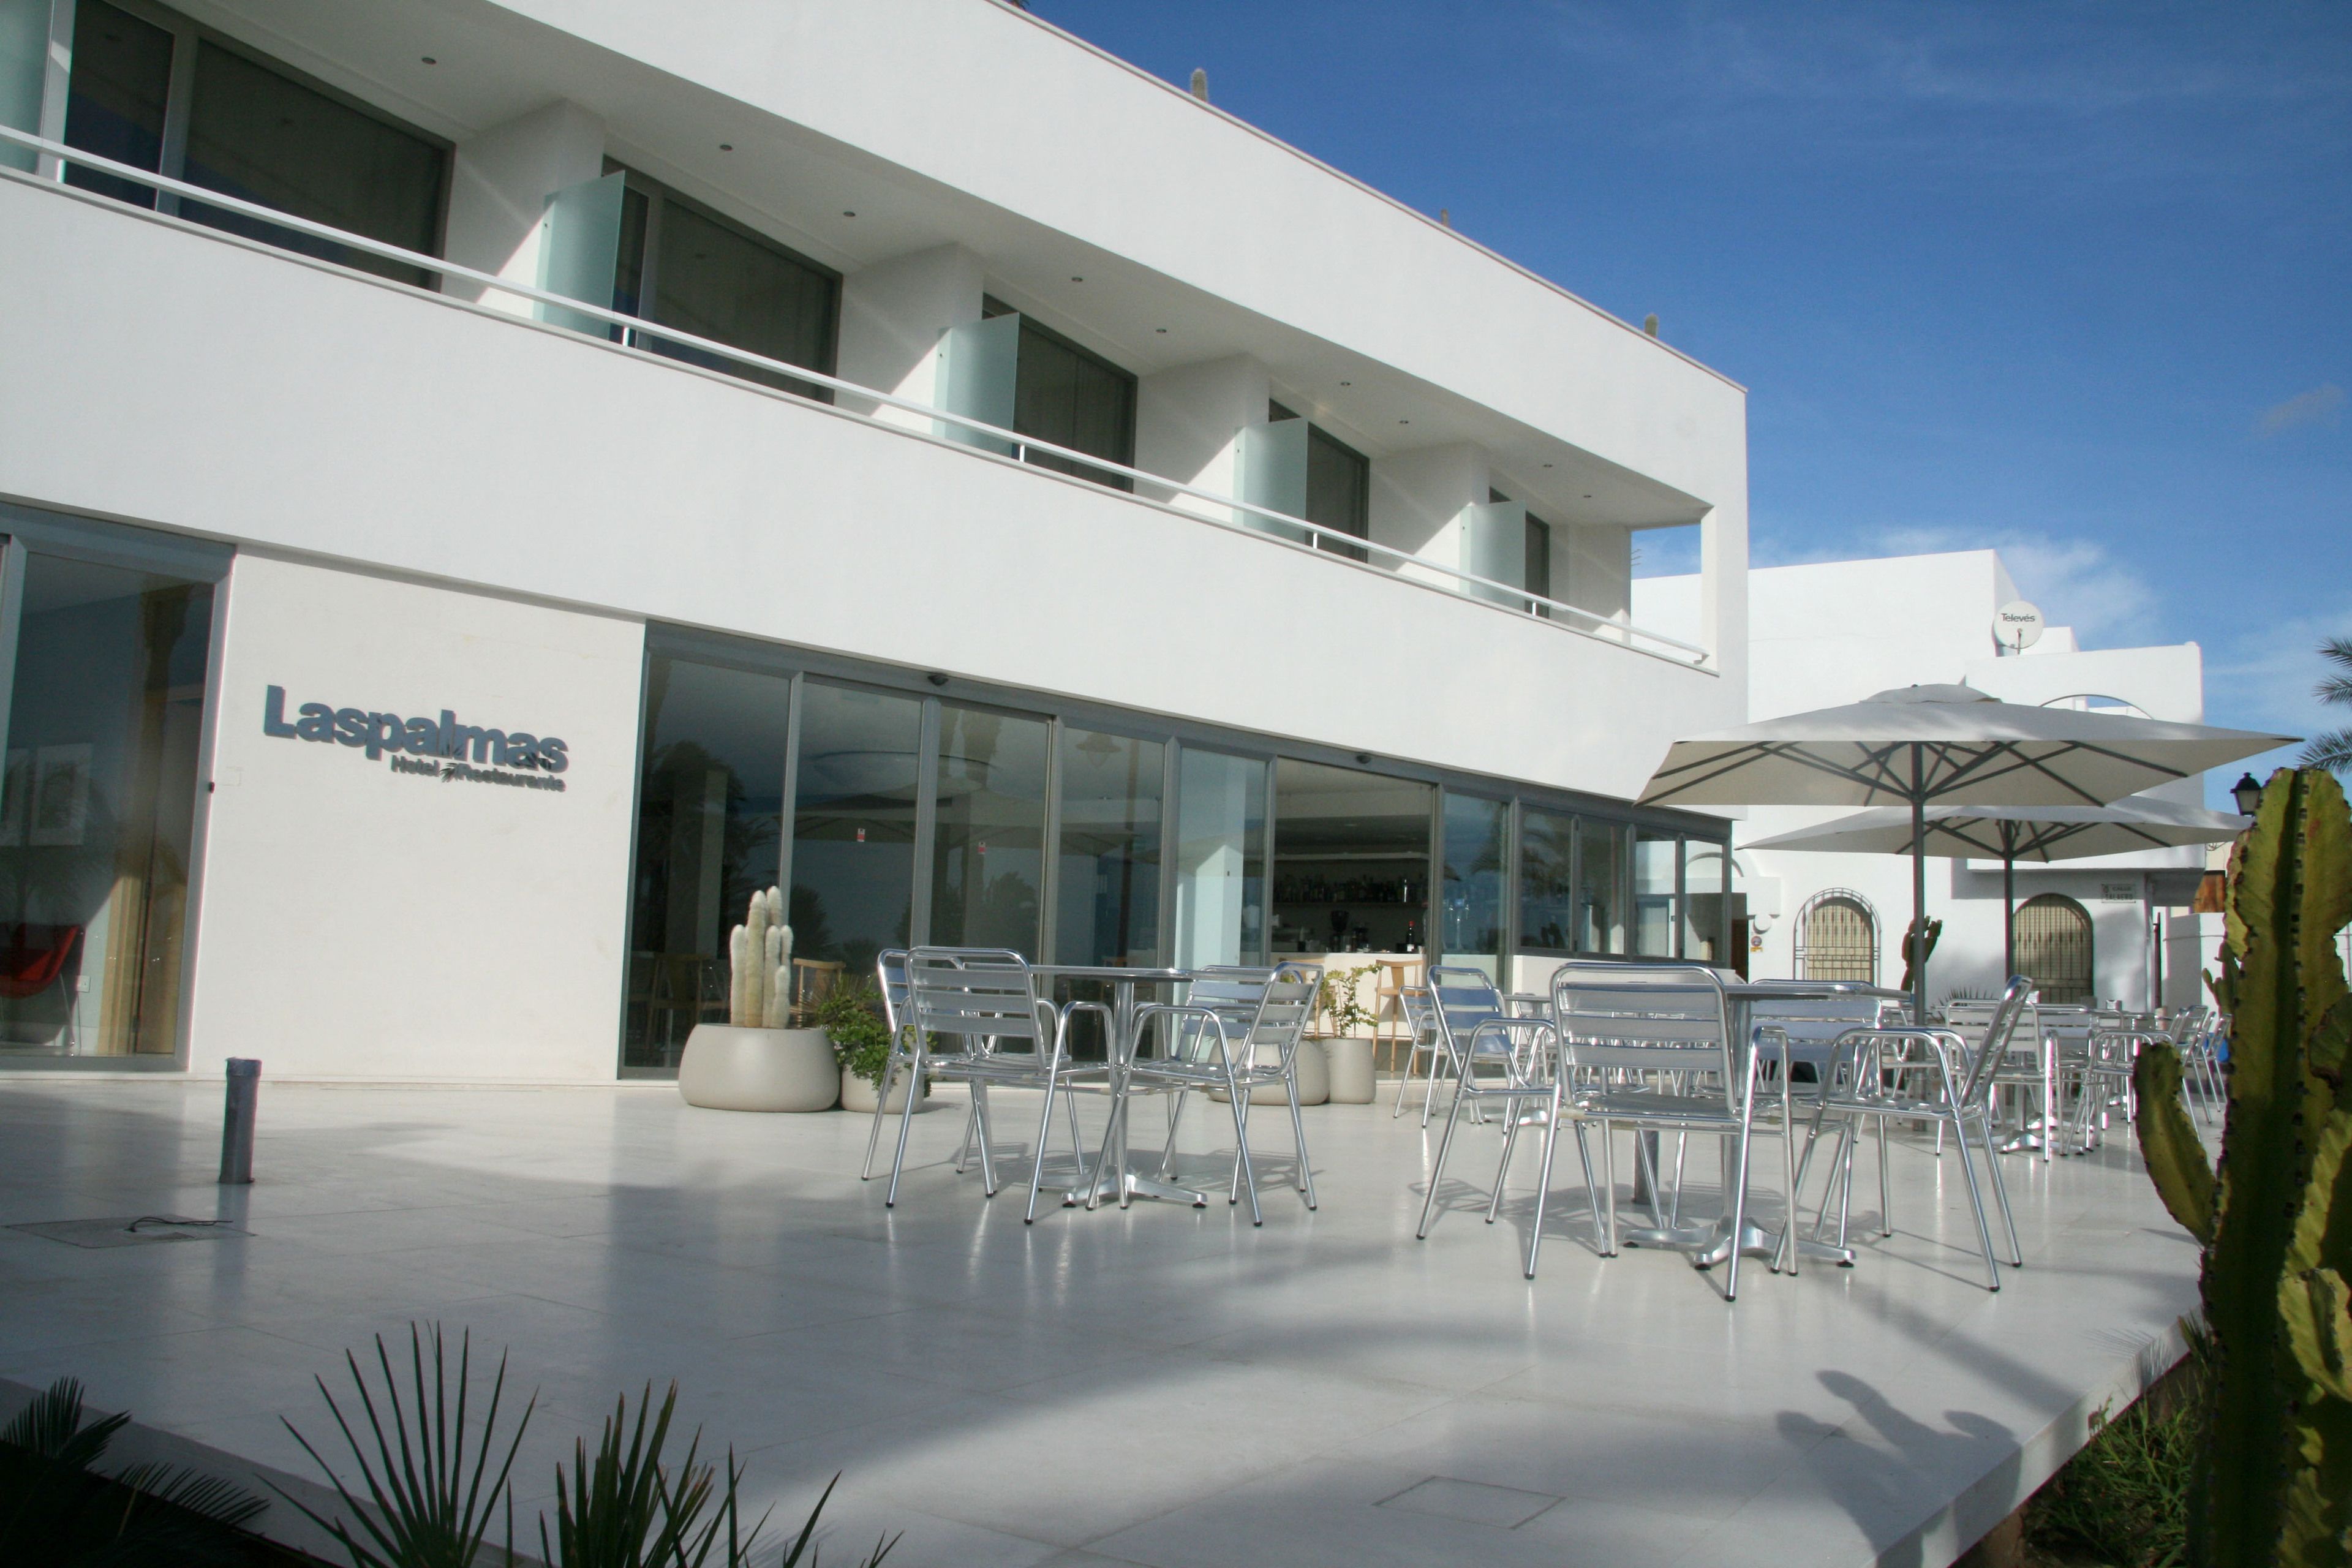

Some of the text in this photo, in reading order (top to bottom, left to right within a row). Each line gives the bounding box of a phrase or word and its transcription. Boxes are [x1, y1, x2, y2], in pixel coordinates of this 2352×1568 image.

[2001, 612, 2035, 622] Televés
[263, 684, 569, 774] Laspalmas
[390, 755, 567, 793] Hotel Restaurante
